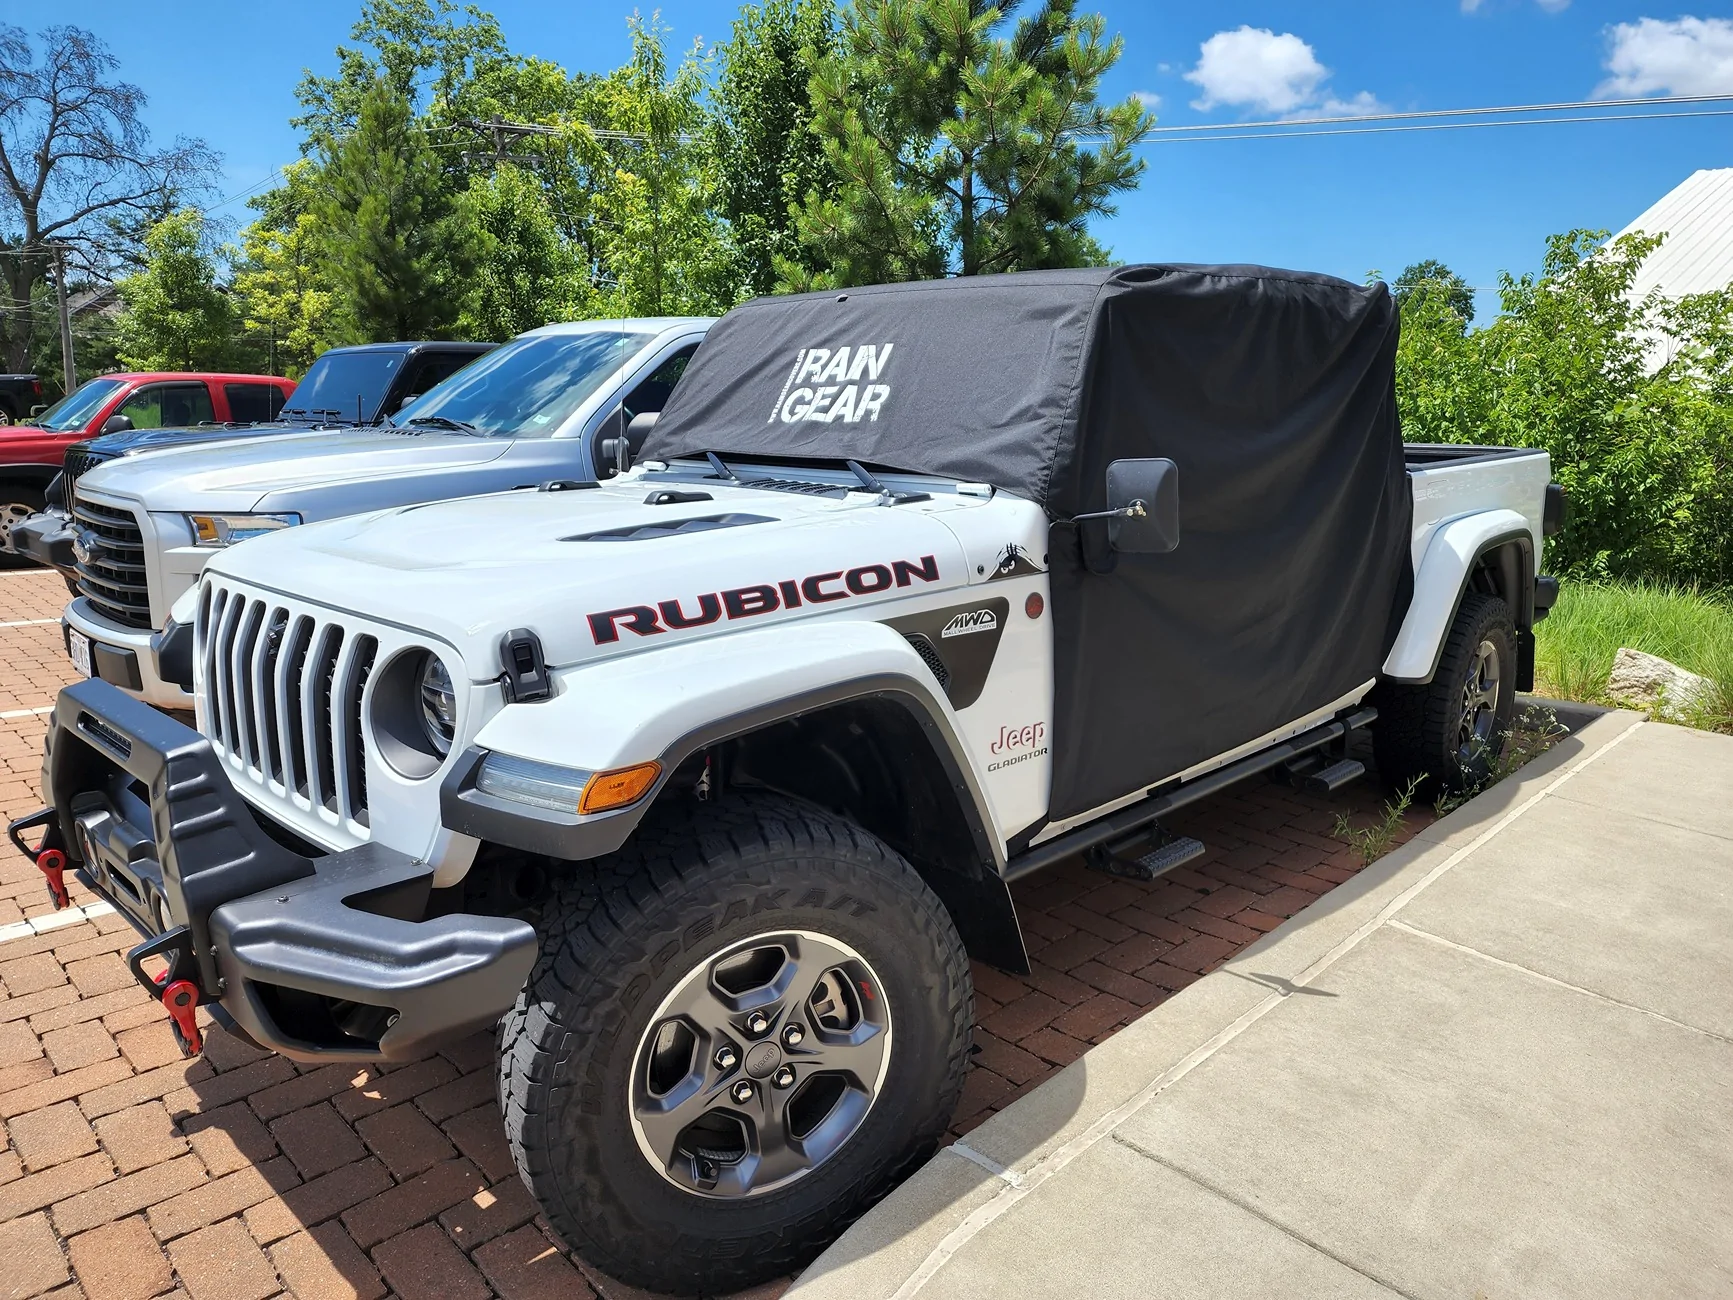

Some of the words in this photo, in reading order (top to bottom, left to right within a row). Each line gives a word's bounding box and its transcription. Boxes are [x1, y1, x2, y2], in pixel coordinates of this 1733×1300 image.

[795, 343, 894, 384] RAIN
[781, 384, 890, 423] GEAR
[585, 554, 940, 645] RUBICON
[944, 610, 996, 631] MWD
[958, 626, 978, 634] WHEEL
[979, 622, 996, 630] DRIVE
[990, 722, 1046, 755] Jeep
[987, 747, 1048, 772] GLADIATOR
[753, 1047, 775, 1072] Jeep
